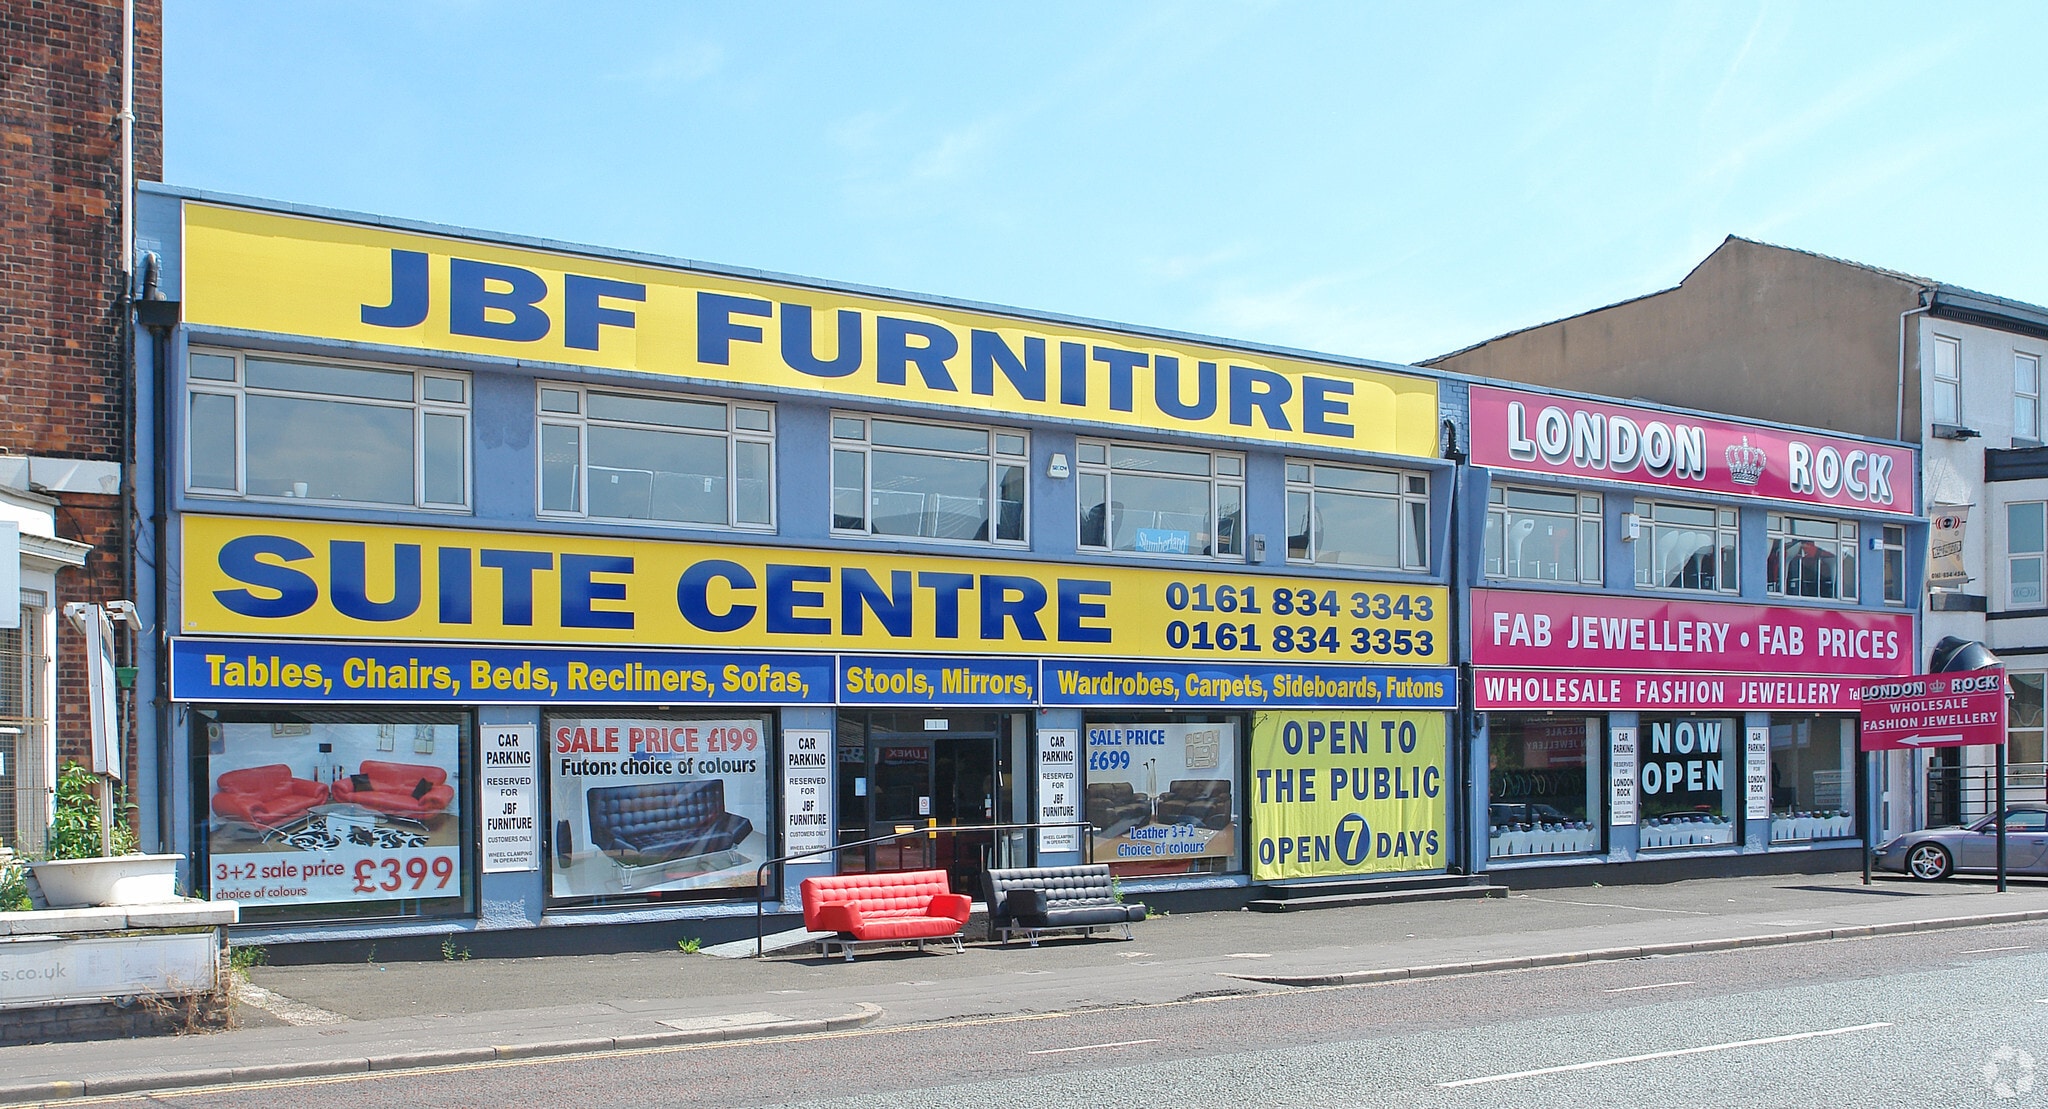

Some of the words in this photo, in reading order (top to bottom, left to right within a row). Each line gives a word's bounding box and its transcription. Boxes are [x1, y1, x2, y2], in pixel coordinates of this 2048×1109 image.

[361, 249, 646, 351] JBF
[697, 292, 1354, 438] FURNITURE
[1508, 401, 1706, 481] LONDON
[1788, 441, 1894, 504] ROCK
[1139, 531, 1187, 553] Slumberland
[212, 535, 634, 629] SUITE
[677, 559, 1112, 643] CENTRE
[1166, 582, 1261, 614] 0161
[1272, 588, 1340, 617] 834
[1350, 592, 1433, 621] 3343
[1166, 621, 1261, 651] 0161
[1272, 625, 1340, 653] 834
[1350, 628, 1433, 656] 3353
[1493, 613, 1552, 647] FAB
[1567, 615, 1730, 653] JEWELLERY
[1758, 625, 1804, 656] FAB
[1819, 628, 1899, 660] PRICES
[206, 655, 332, 695] Tables,
[343, 657, 460, 696] Chairs,
[470, 660, 558, 697] Beds,
[568, 662, 715, 698] Recliners,
[722, 664, 810, 698] Sofas,
[847, 667, 934, 699] Stools,
[942, 668, 1033, 699] Mirrors,
[1057, 670, 1180, 701] Wardrobes,
[1185, 673, 1268, 702] Carpets,
[1273, 675, 1382, 703] Sideboards,
[1387, 676, 1444, 698] Futons
[1484, 677, 1621, 703] WHOLESALE
[1636, 680, 1724, 704] FASHION
[1739, 682, 1840, 705] JEWELLERY
[1849, 688, 1860, 700] Tel
[1861, 681, 1926, 700] LONDON
[1952, 675, 1999, 693] ROCK
[1890, 698, 1968, 713] WHOLESALE
[1863, 717, 1918, 731] FASHION
[1922, 712, 1997, 727] JEWELLERY
[498, 734, 518, 747] CAR
[557, 728, 618, 753] SALE
[629, 728, 698, 752] PRICE
[707, 728, 757, 752] £199
[799, 738, 816, 750] CAR
[1050, 736, 1065, 748] CAR
[1090, 730, 1121, 745] SALE
[1126, 729, 1165, 745] PRICE
[1283, 720, 1368, 755] OPEN
[1381, 720, 1416, 753] TO
[1619, 732, 1628, 741] CAR
[1652, 722, 1721, 754] NOW
[1753, 732, 1761, 741] CAR
[1613, 744, 1633, 753] PARKING
[486, 751, 531, 764] PARKING
[789, 753, 826, 766] PARKING
[1042, 751, 1073, 762] PARKING
[1089, 750, 1130, 770] £699
[561, 758, 616, 775] Futon:
[621, 757, 672, 774] choice
[678, 758, 694, 774] of
[699, 757, 756, 774] colours
[487, 777, 531, 785] RESERVED
[789, 777, 826, 785] RESERVED
[1043, 772, 1074, 780] RESERVED
[1614, 778, 1634, 787] LONDON
[1642, 760, 1724, 794] OPEN
[1748, 775, 1766, 783] LONDON
[801, 787, 815, 795] FOR
[1257, 769, 1316, 803] THE
[1331, 766, 1440, 801] PUBLIC
[1053, 794, 1064, 805] JBF
[1616, 788, 1630, 797] ROCK
[502, 802, 517, 815] JBF
[802, 801, 814, 812] JBF
[1043, 806, 1074, 817] FURNITURE
[488, 817, 532, 830] FURNITURE
[790, 813, 827, 826] FURNITURE
[1130, 826, 1168, 840] Leather
[1171, 824, 1194, 838] 3+2
[1117, 843, 1151, 857] Choice
[1155, 842, 1166, 855] of
[1169, 842, 1204, 854] colours
[1259, 835, 1330, 865] OPEN
[1343, 820, 1363, 861] 7
[1377, 830, 1439, 858] DAYS
[216, 863, 256, 880] 3+2
[262, 860, 297, 878] sale
[303, 859, 345, 882] price
[353, 857, 453, 893] £399
[216, 888, 250, 900] choice
[254, 887, 266, 898] of
[268, 886, 307, 898] colours
